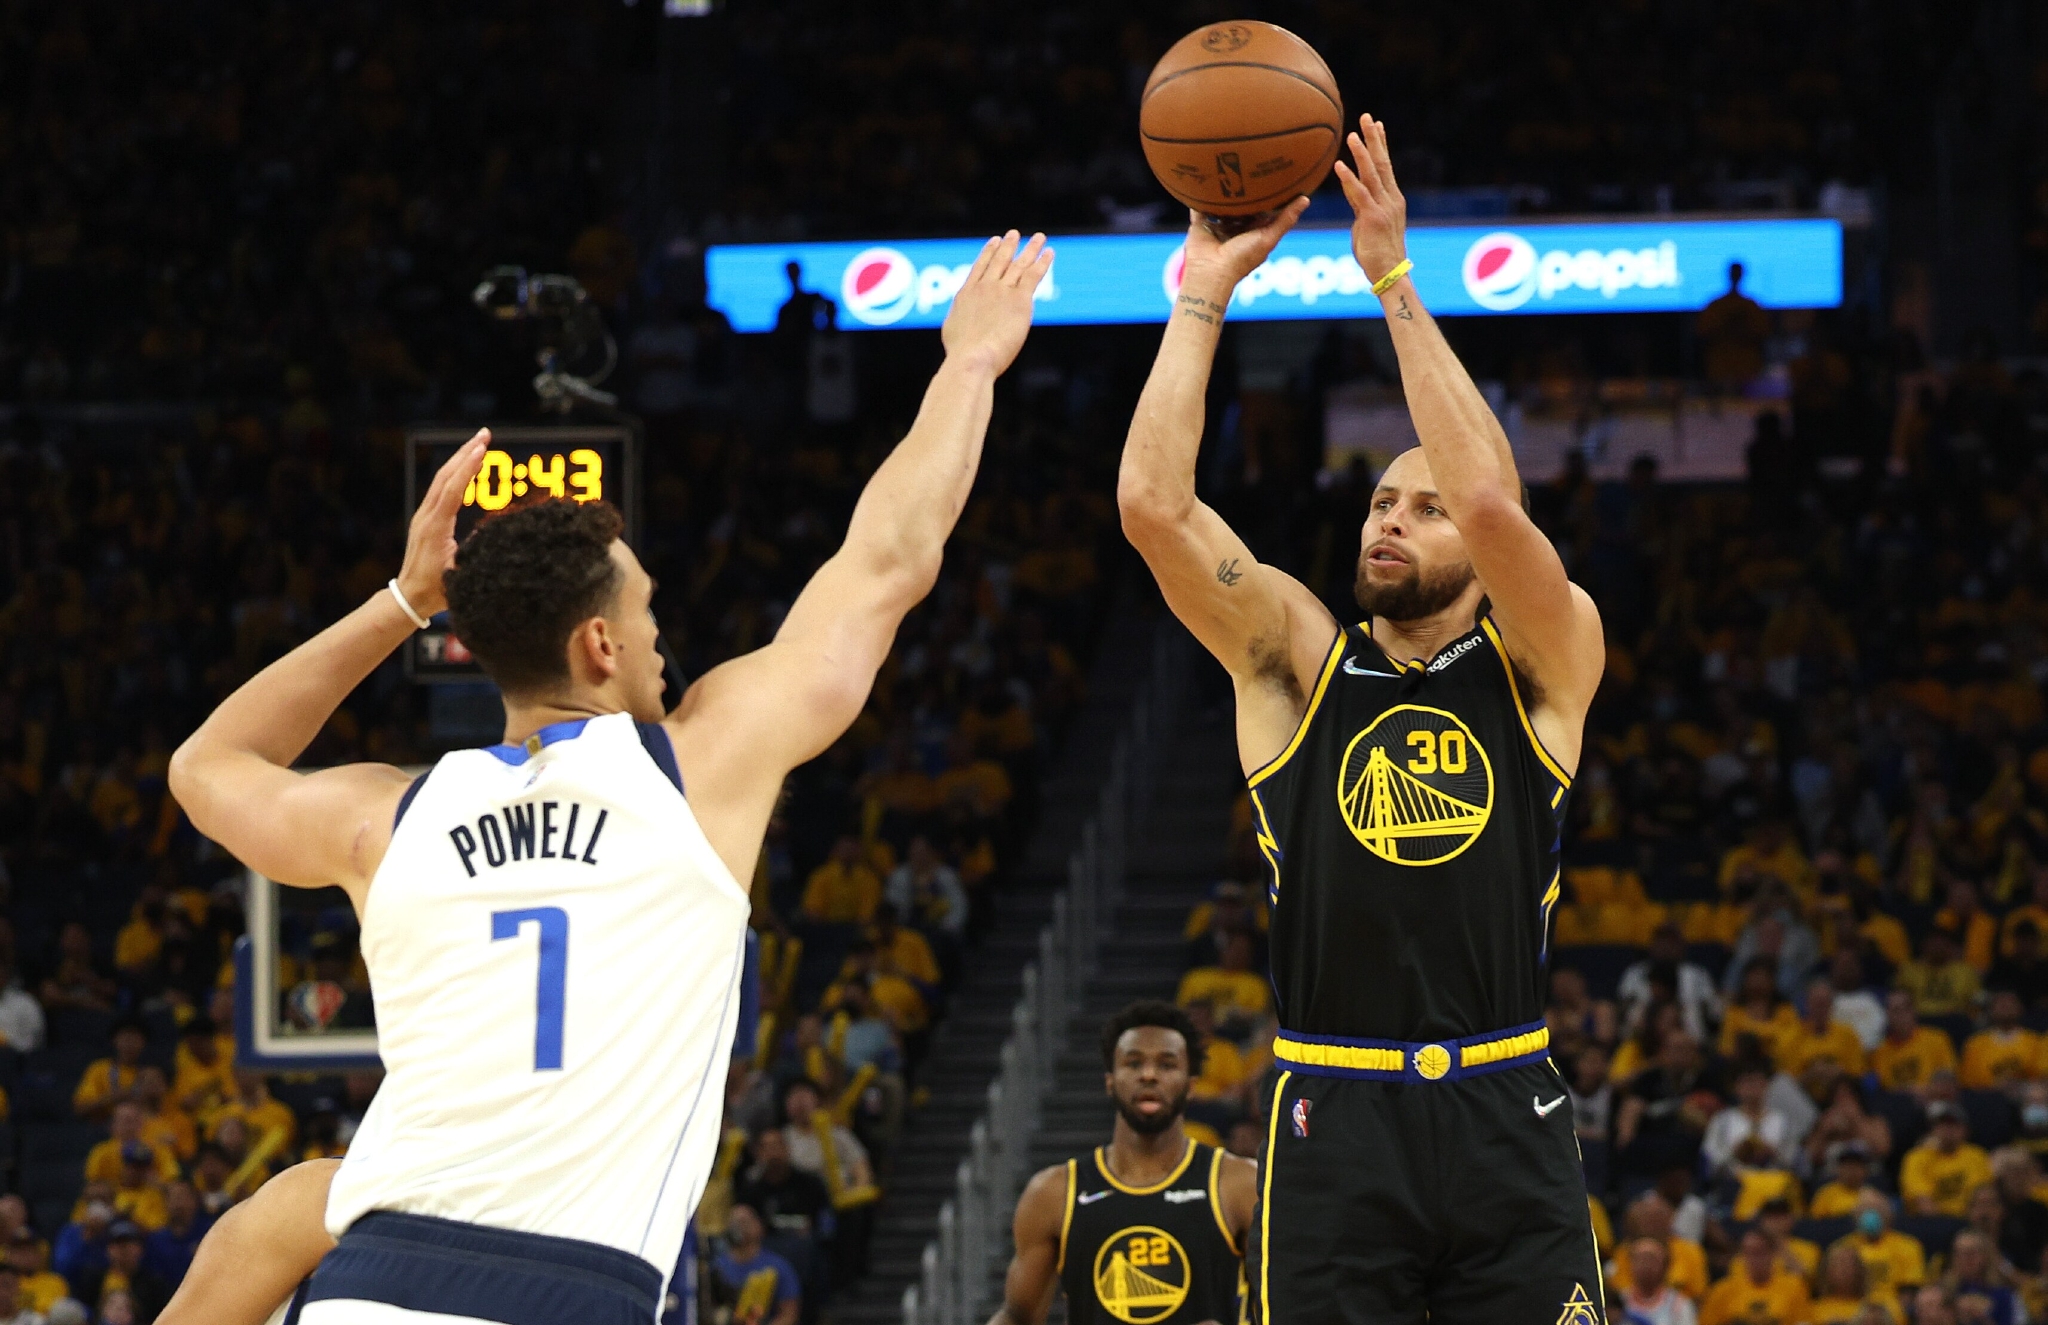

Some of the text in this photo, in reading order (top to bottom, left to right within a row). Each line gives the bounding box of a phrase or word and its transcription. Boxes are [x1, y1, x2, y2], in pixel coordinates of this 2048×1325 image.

[1236, 254, 1372, 305] peps
[1538, 240, 1678, 299] pepsi
[1406, 730, 1467, 774] 30
[449, 802, 608, 878] POWELL
[491, 906, 569, 1072] 7
[1128, 1236, 1171, 1267] 22
